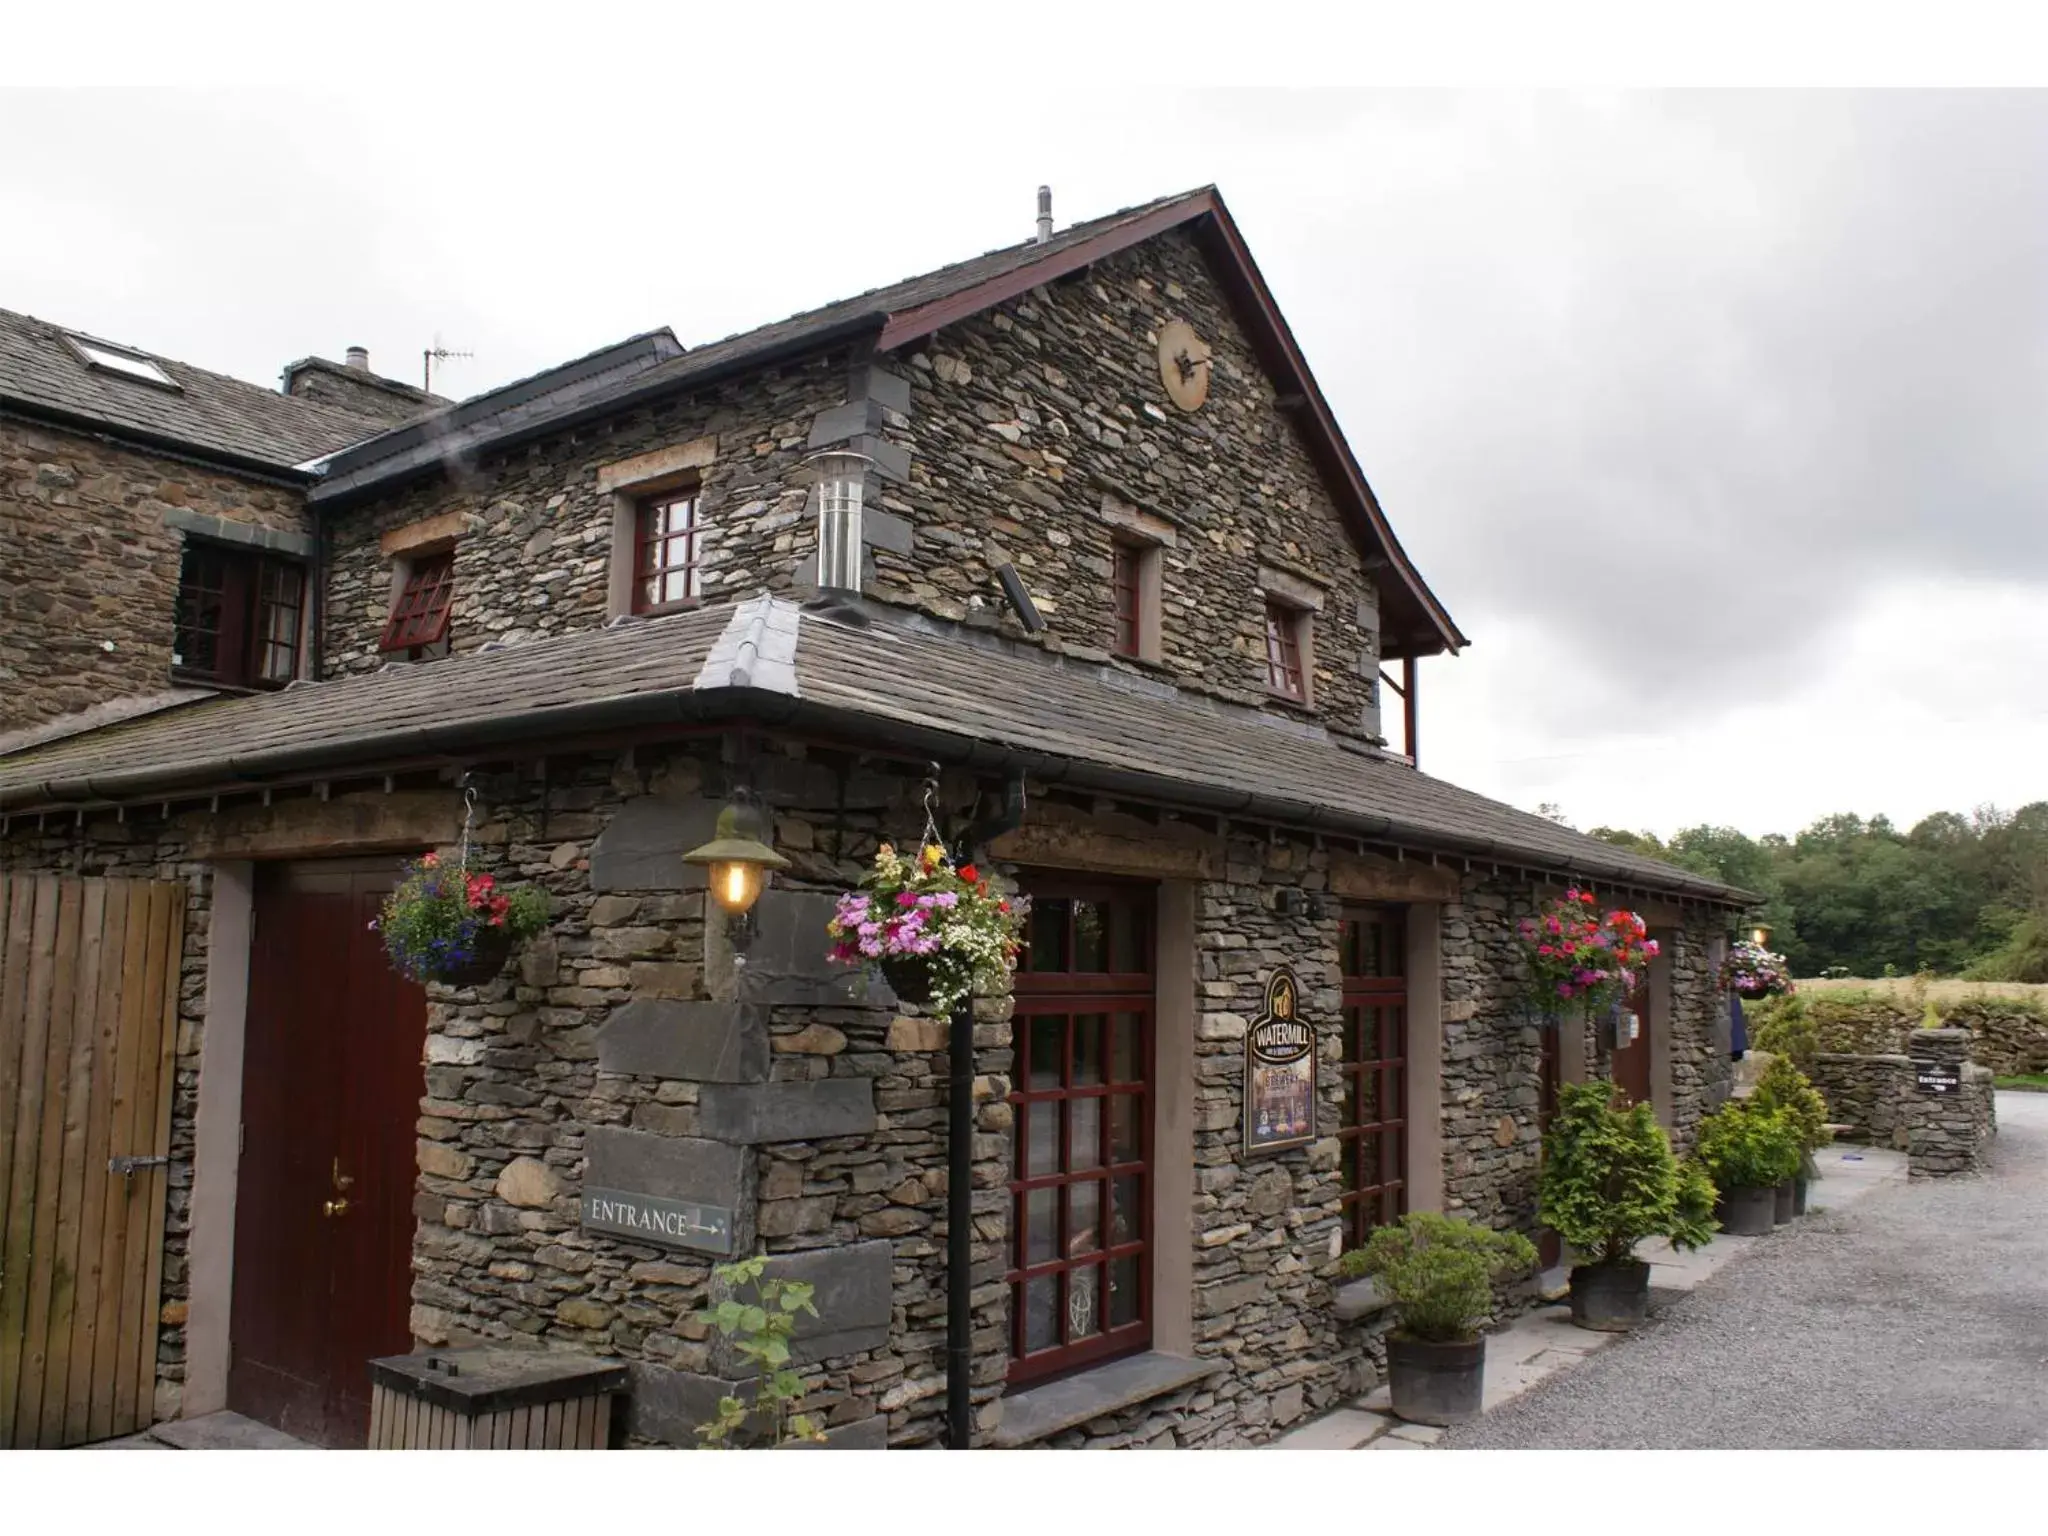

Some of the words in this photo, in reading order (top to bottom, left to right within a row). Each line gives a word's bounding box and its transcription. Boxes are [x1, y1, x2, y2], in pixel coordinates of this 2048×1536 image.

[1256, 1023, 1309, 1047] WATERMILL
[1919, 1076, 1957, 1085] Entrance
[591, 1198, 687, 1236] ENTRANCE
